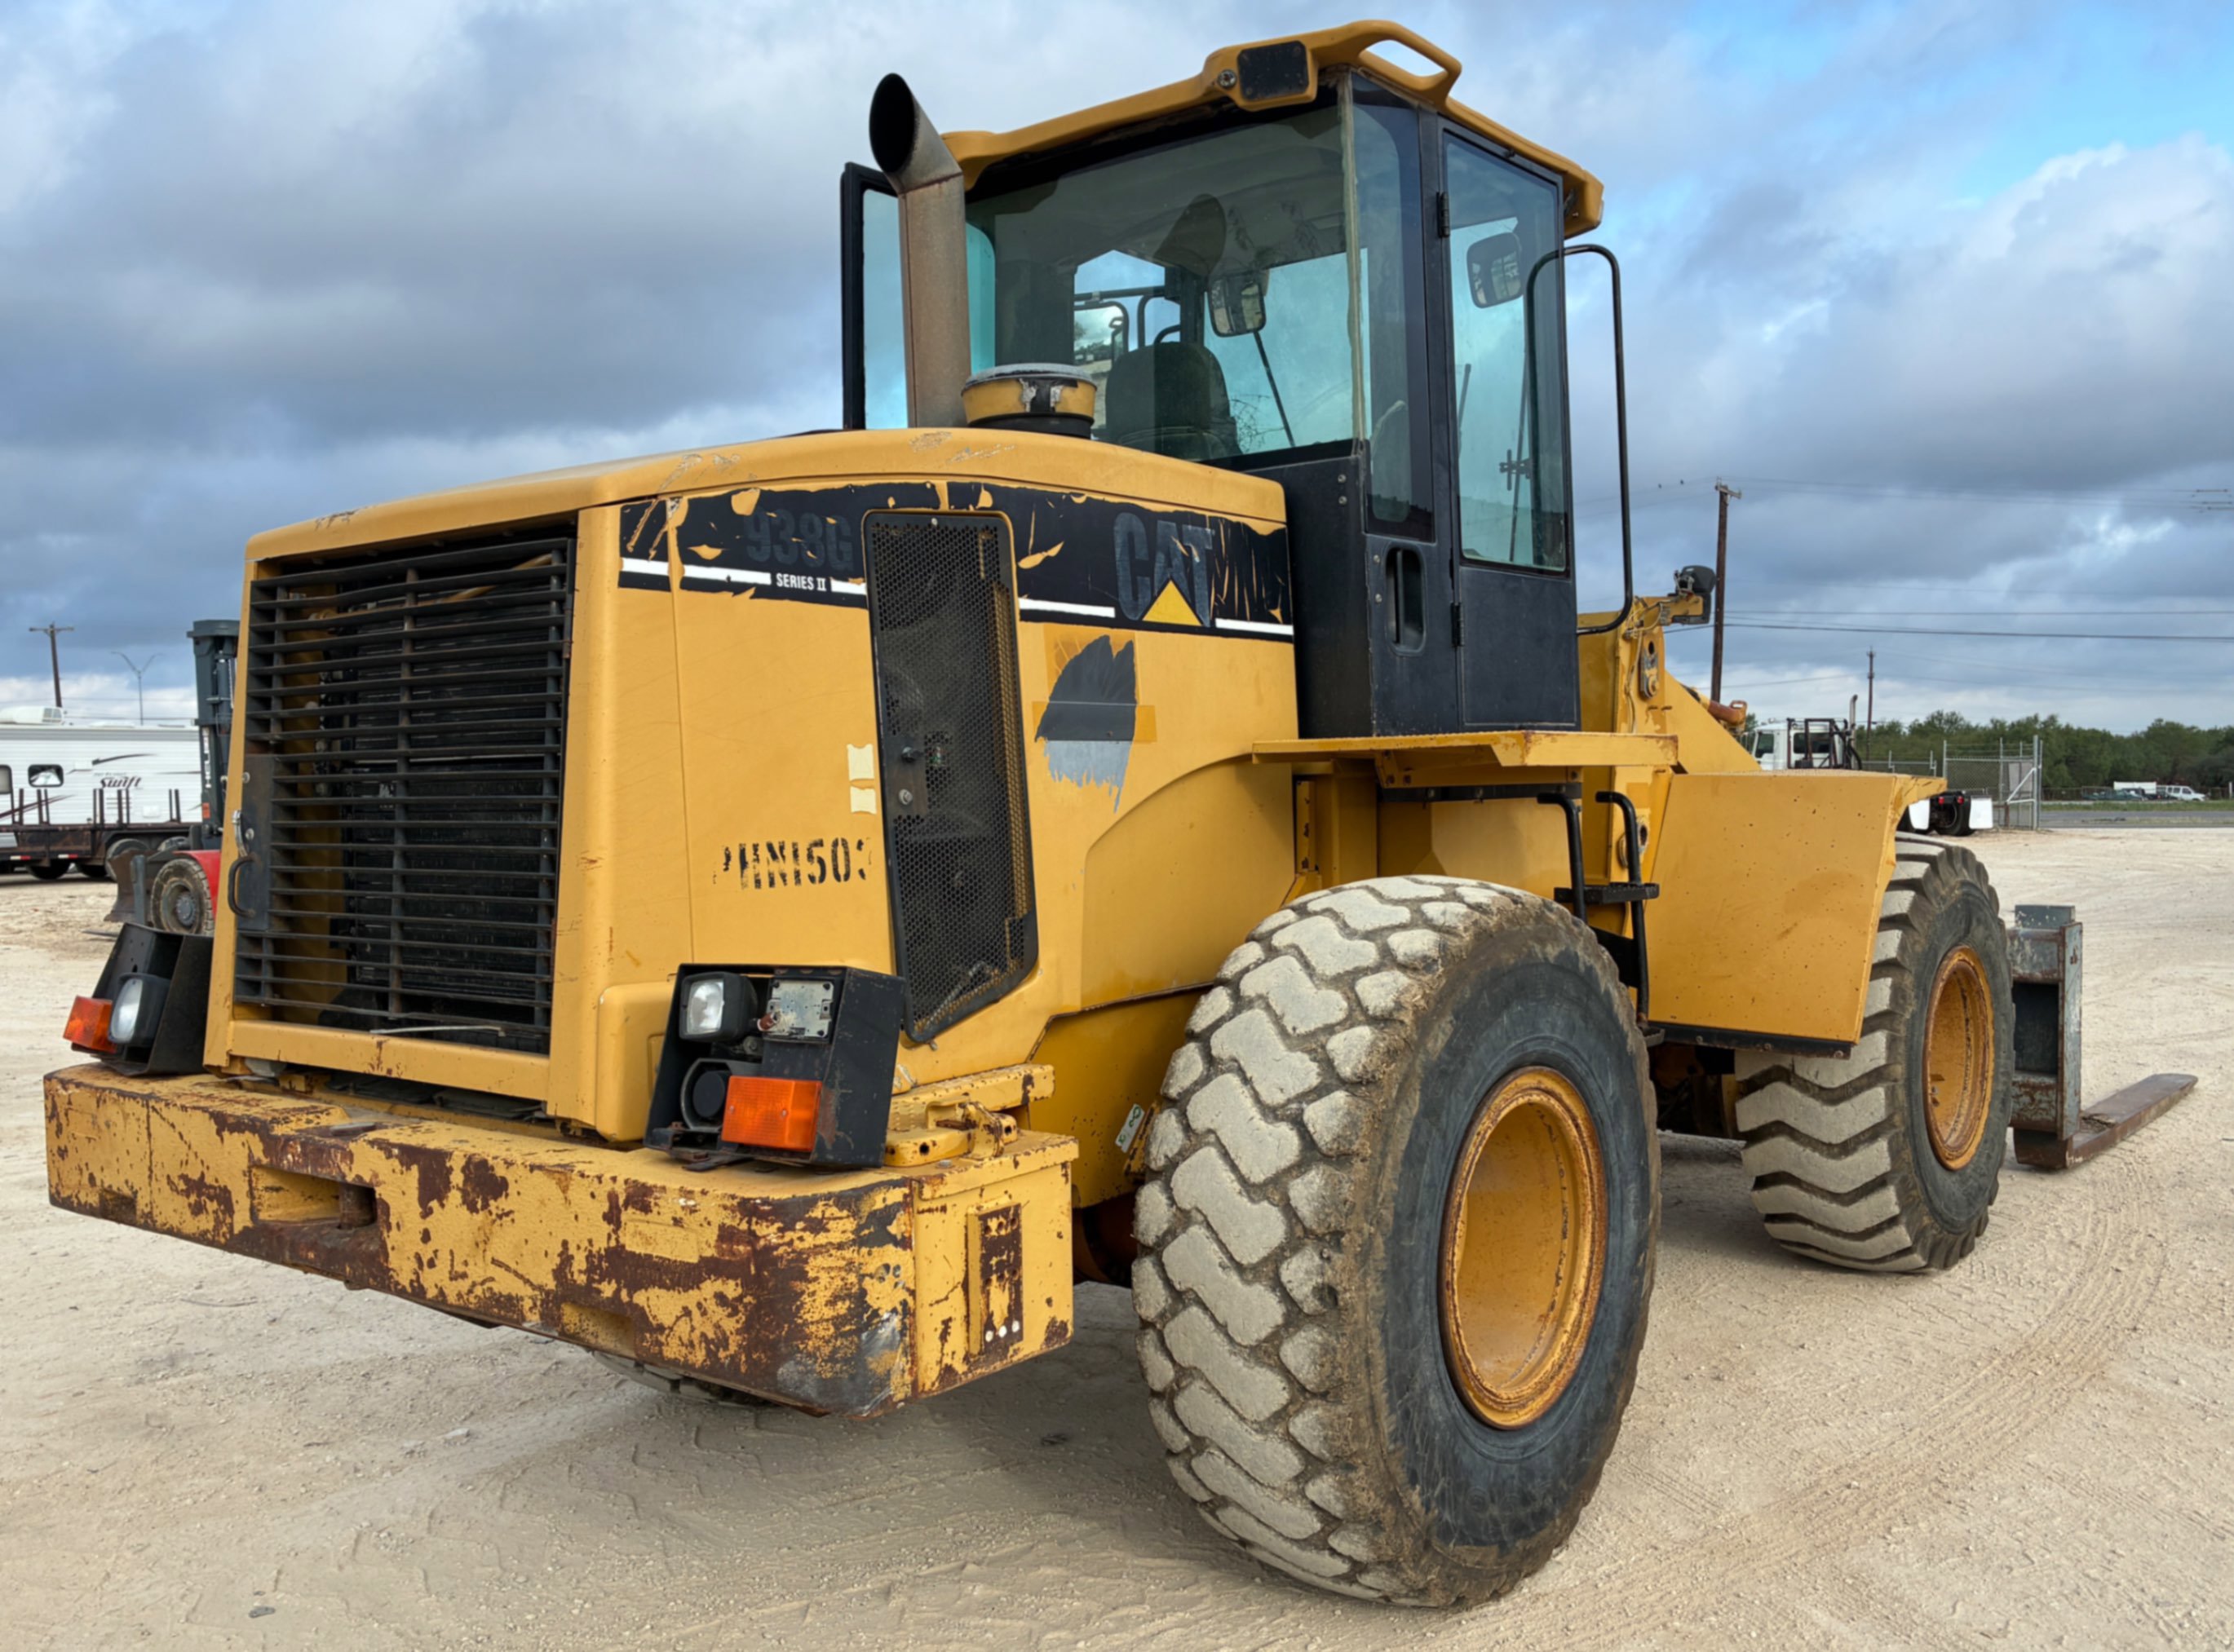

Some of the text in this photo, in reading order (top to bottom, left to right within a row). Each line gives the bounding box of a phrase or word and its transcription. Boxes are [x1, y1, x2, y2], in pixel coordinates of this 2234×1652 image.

[744, 506, 854, 571] 938G
[1113, 511, 1213, 627] CAT
[776, 572, 827, 592] SERIES II
